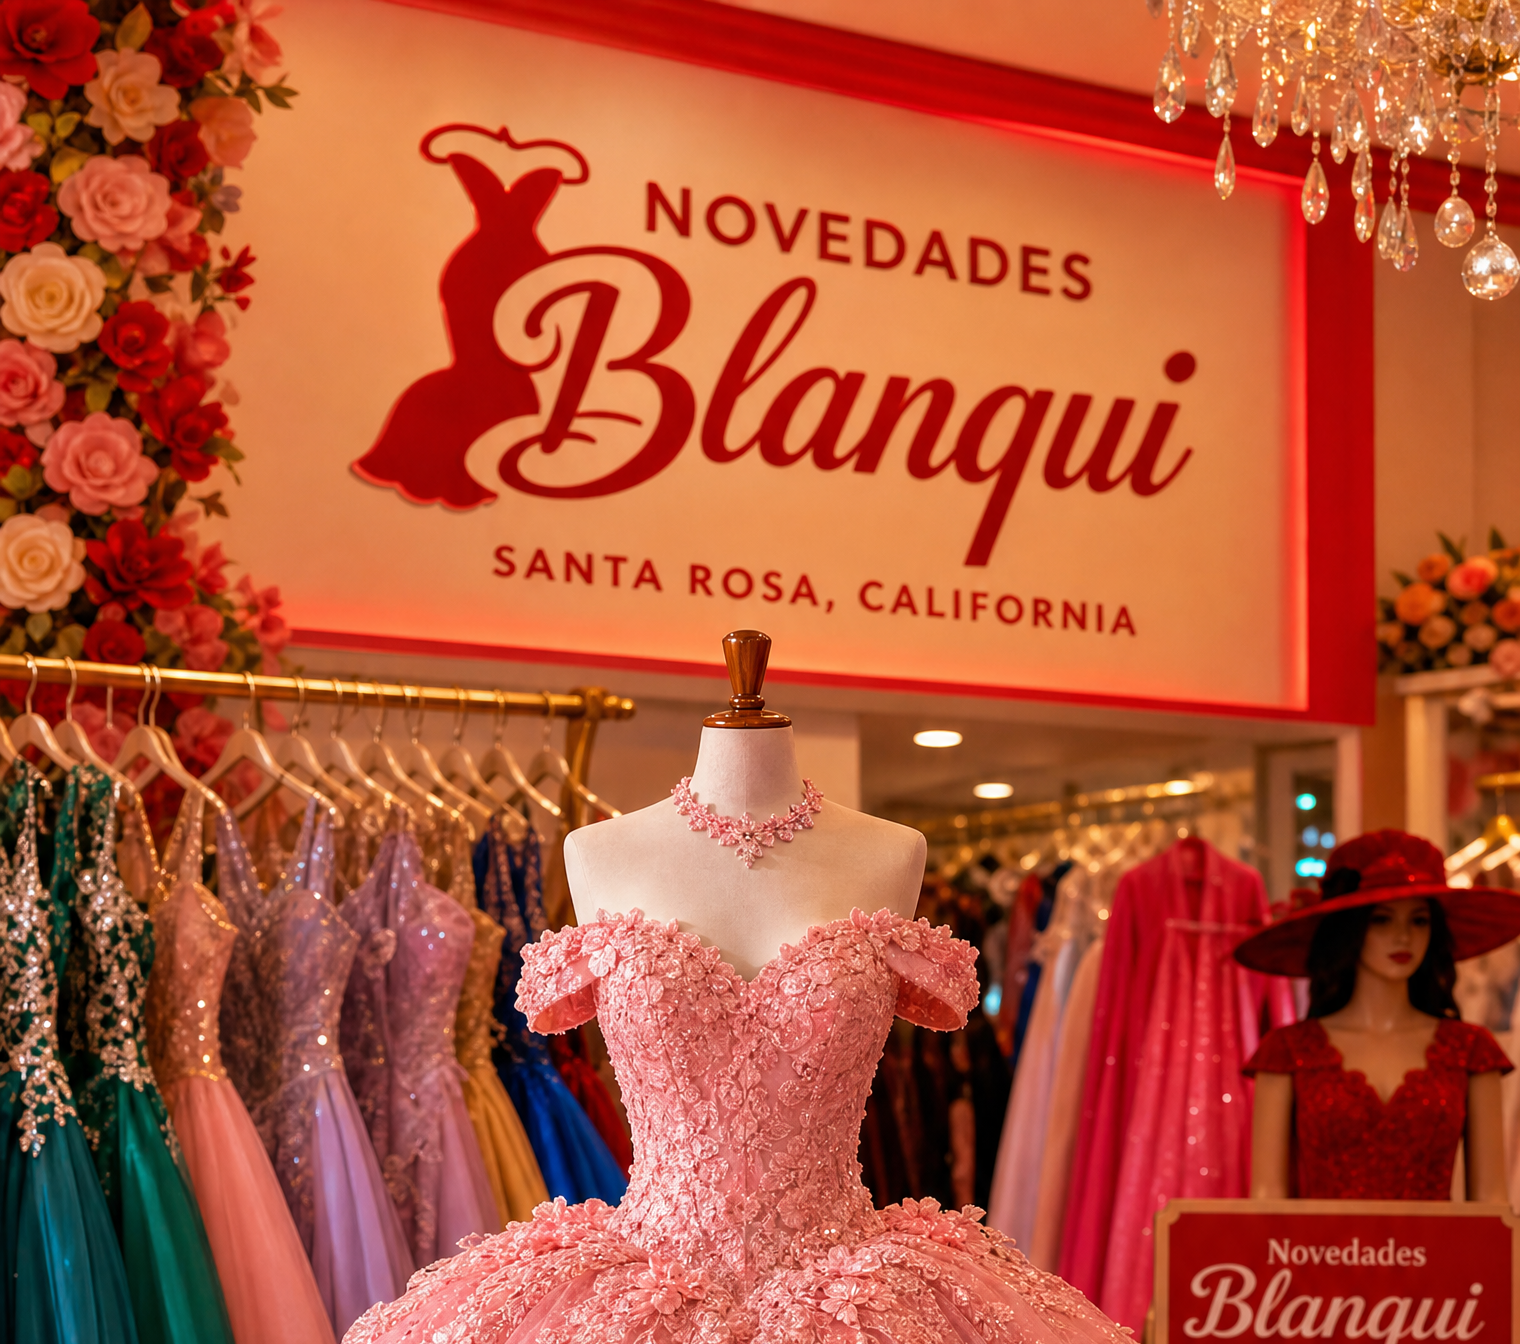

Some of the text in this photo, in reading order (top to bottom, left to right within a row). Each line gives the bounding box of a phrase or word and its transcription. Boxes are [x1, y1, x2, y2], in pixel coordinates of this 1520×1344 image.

[645, 181, 1094, 302] NOVEDADES
[498, 245, 1198, 567] Blanqui
[492, 543, 1138, 637] SANTA ROSA, CALIFORNIA
[1267, 1238, 1427, 1267] Novedades
